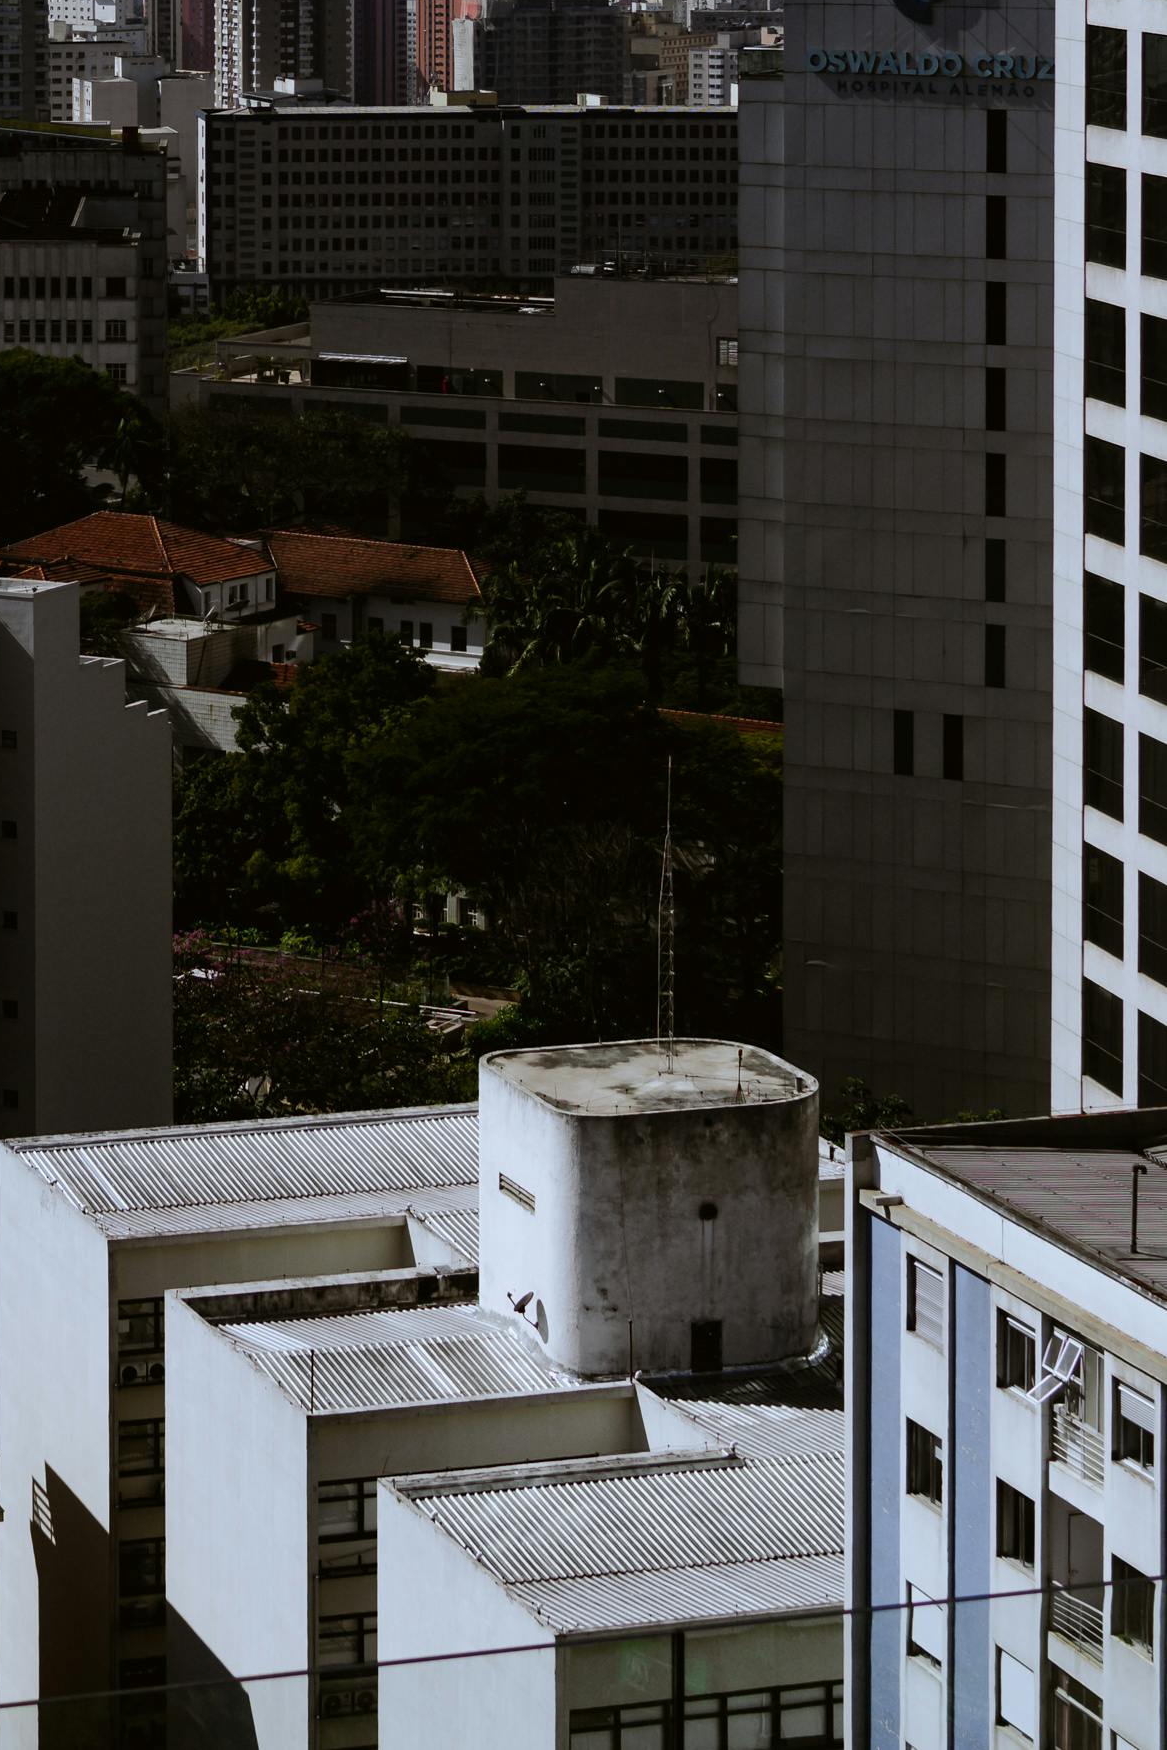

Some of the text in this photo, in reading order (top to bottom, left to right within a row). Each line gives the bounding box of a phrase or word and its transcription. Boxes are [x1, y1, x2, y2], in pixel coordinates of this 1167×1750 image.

[806, 49, 1055, 80] OSWALDO CRUZ
[837, 80, 1035, 97] HOSPITAL ALEMÃO
